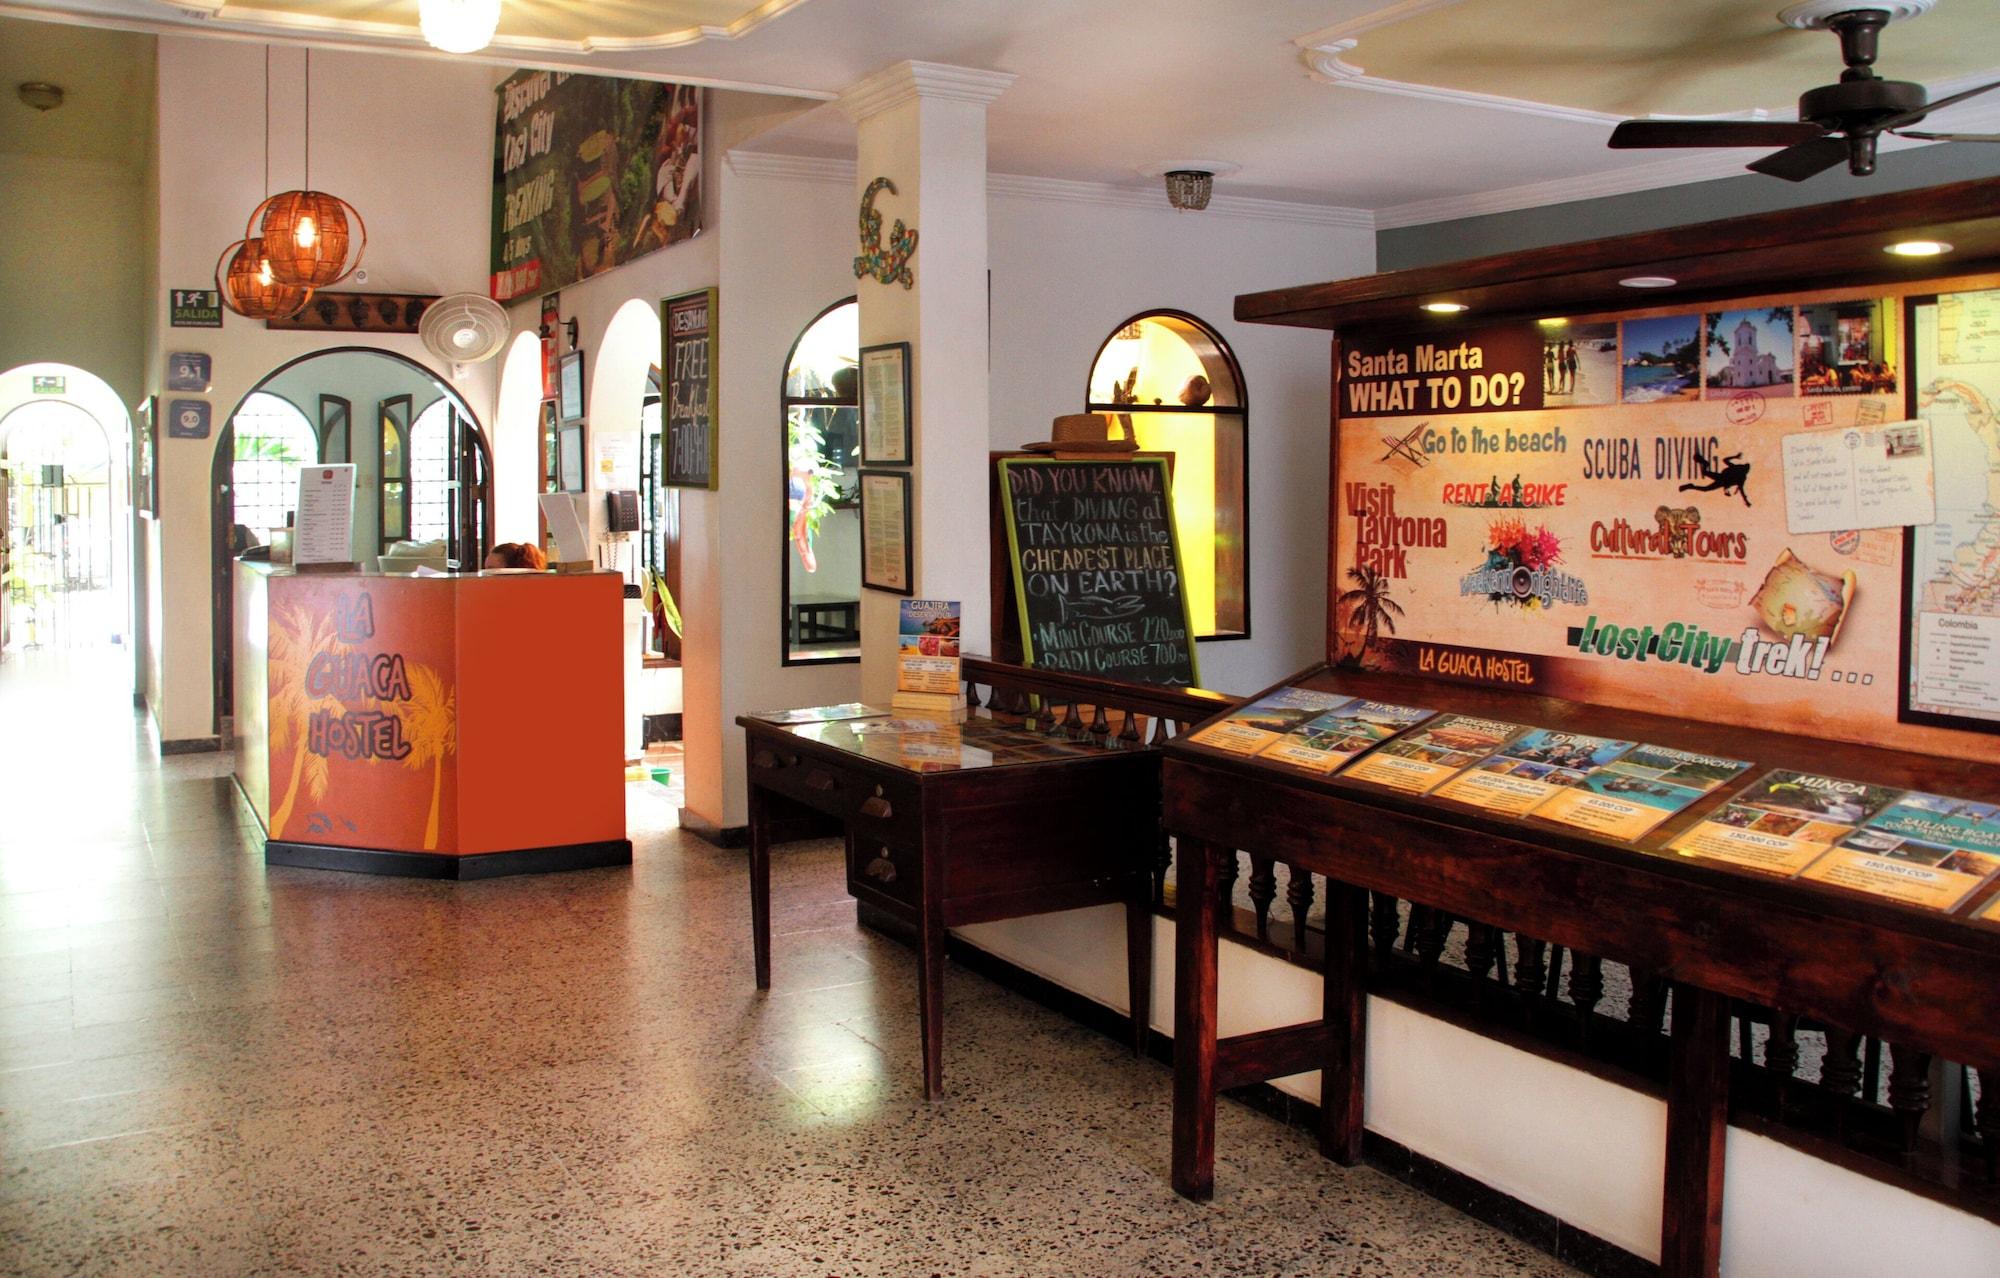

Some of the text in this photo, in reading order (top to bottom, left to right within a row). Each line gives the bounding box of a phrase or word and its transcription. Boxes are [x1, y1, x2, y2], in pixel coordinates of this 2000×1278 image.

[176, 309, 218, 319] SALIDA
[674, 337, 710, 381] FREE
[1348, 342, 1483, 378] Santa Marta
[1350, 372, 1525, 412] WHAT TO DO?
[1423, 429, 1446, 453] Go
[1505, 427, 1567, 453] beach
[1583, 436, 1719, 480] SCUBA DIVING
[1007, 467, 1043, 495] DID
[1048, 467, 1087, 495] YOU
[1442, 482, 1568, 506] RENT A BIKE
[1074, 497, 1137, 520] DIVING
[1142, 495, 1163, 519] at
[1345, 482, 1396, 518] Visit
[1020, 521, 1168, 545] TAYRONA is the
[1356, 515, 1447, 549] Tayrona
[1590, 518, 1747, 559] Cultural Tours
[1124, 546, 1175, 570] PLACE
[1356, 542, 1408, 579] Park
[1027, 570, 1177, 597] ON EARTH?
[337, 591, 375, 644] LA
[911, 601, 950, 610] GUAJIRA
[1938, 618, 1978, 630] Colombia
[1578, 615, 1654, 662] Lost
[1656, 621, 1732, 674] City
[1735, 627, 1830, 681] trek!
[305, 651, 412, 702] GUACA
[1420, 648, 1534, 685] LA GUACA HOSTEL
[308, 710, 412, 761] HOSTEL
[1791, 775, 1867, 796] MINCA
[1903, 817, 1960, 833] SAILING
